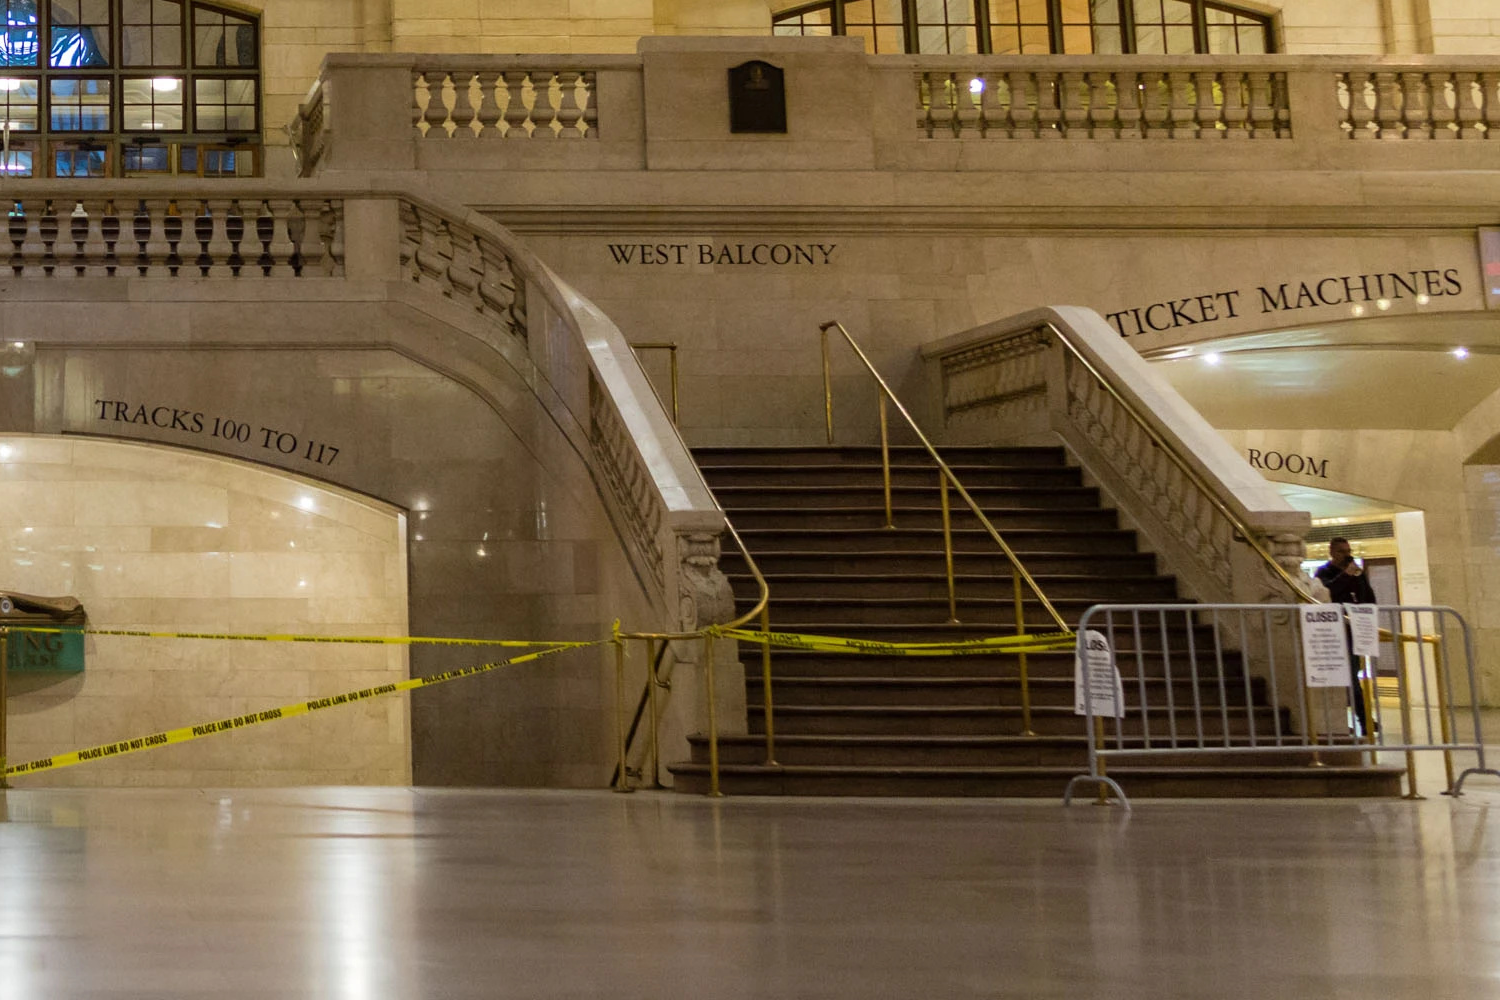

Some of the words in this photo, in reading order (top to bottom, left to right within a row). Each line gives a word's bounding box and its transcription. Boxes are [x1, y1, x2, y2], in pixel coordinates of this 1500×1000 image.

[607, 243, 688, 265] WEST
[697, 243, 837, 265] BALCONY
[1106, 290, 1240, 338] TICKET
[1257, 268, 1463, 314] MACHINES
[95, 399, 205, 433] TRACKS
[211, 417, 251, 443] 100
[260, 427, 297, 454] TO
[304, 440, 340, 466] 117
[1248, 448, 1330, 479] ROOM
[1305, 611, 1339, 623] CLOSED
[307, 699, 331, 711] POLICE
[331, 695, 347, 705] LINE
[348, 692, 358, 701] DO
[358, 689, 373, 699] NOT
[192, 723, 216, 737] POLICE
[217, 719, 233, 731] LINE
[234, 716, 244, 727] DO
[244, 714, 258, 725] NOT
[259, 708, 282, 722] CROSS
[78, 750, 102, 761] POLICE
[103, 746, 118, 756] LINE
[119, 742, 129, 752] DO
[130, 739, 144, 749] NOT
[145, 734, 168, 746] CROSS
[16, 763, 29, 772] NOT
[30, 758, 53, 770] CROSS
